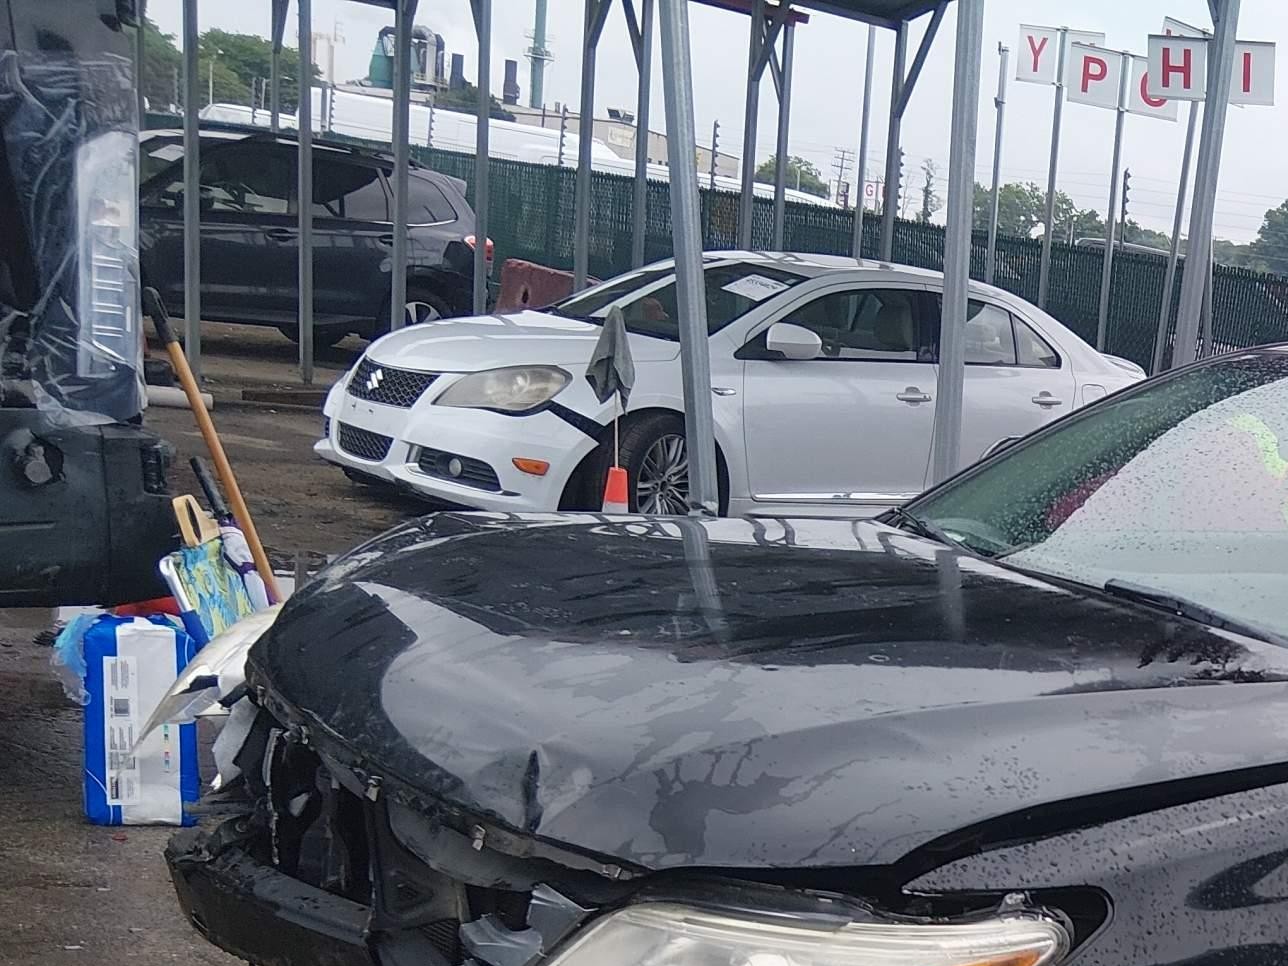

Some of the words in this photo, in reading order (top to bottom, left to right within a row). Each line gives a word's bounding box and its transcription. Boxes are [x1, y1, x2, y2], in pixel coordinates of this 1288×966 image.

[1027, 36, 1048, 72] Y
[1162, 47, 1191, 89] H
[1081, 55, 1107, 93] P
